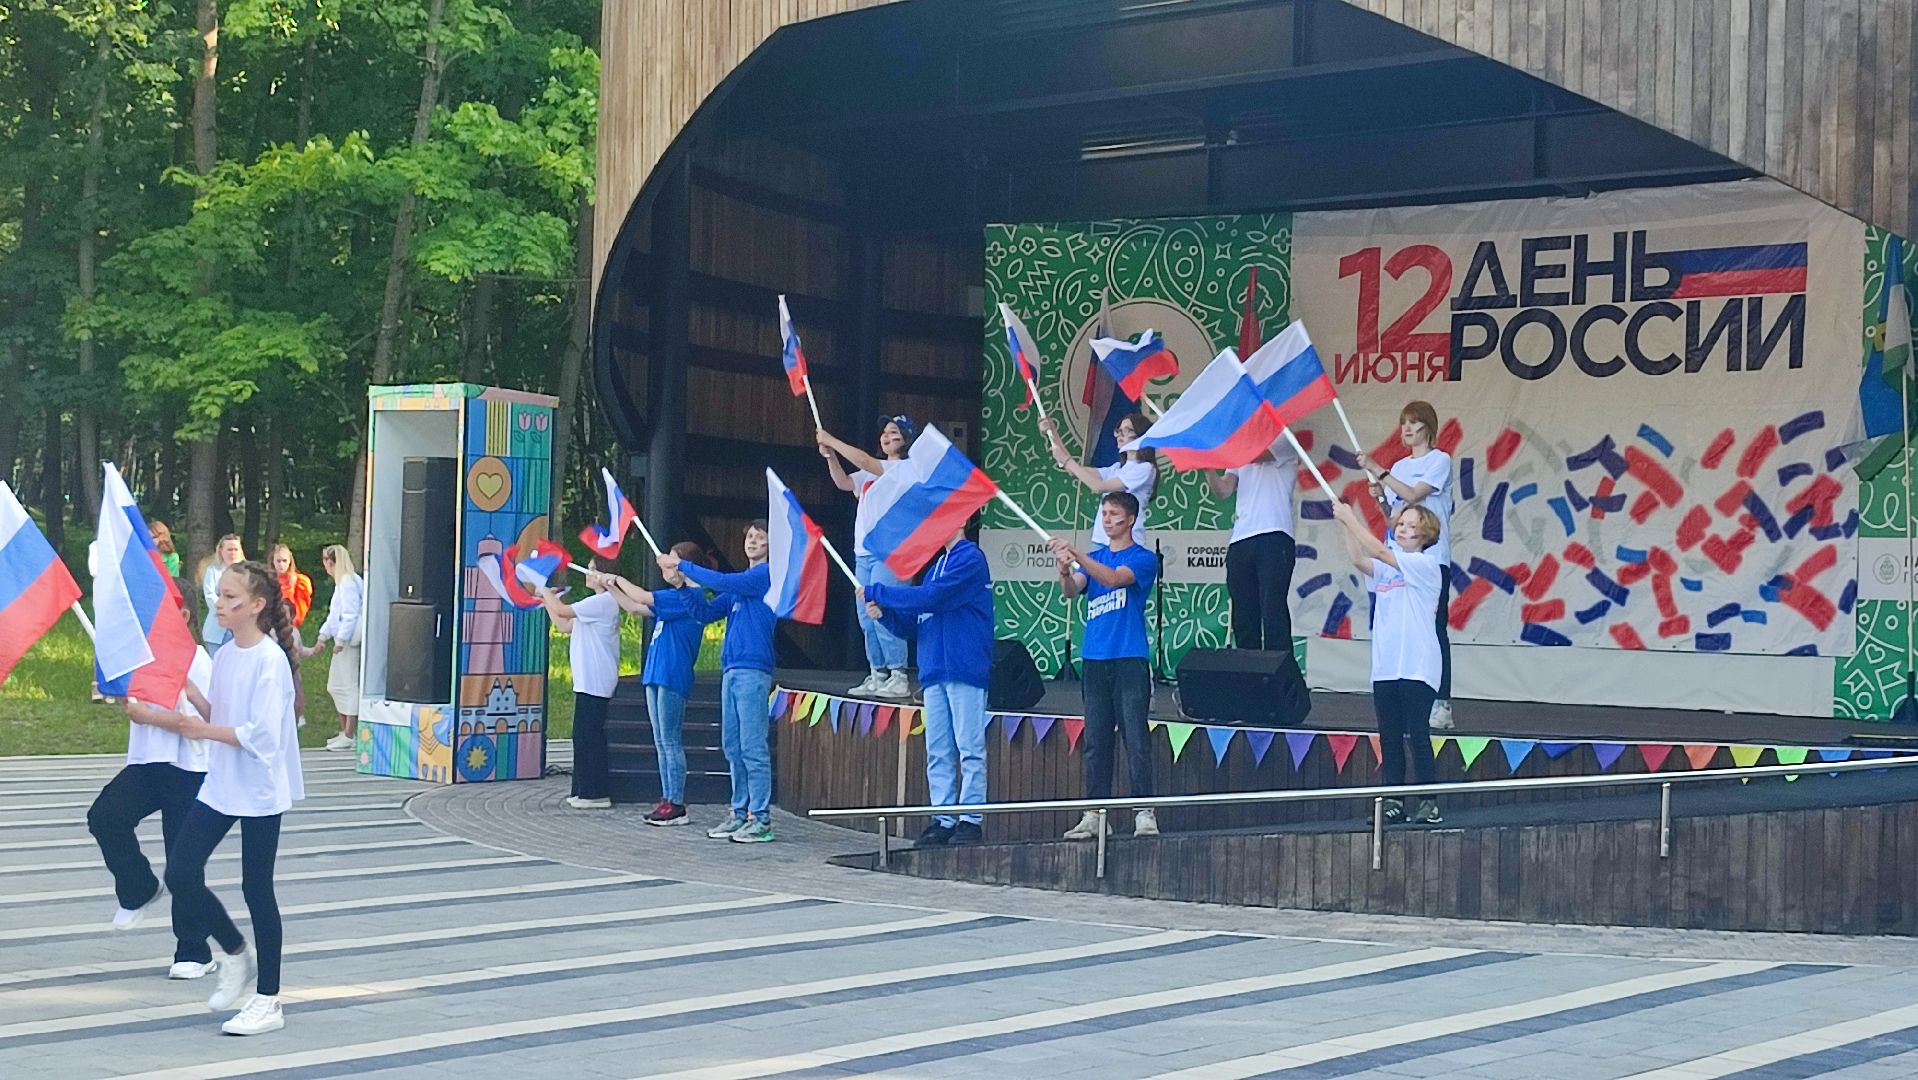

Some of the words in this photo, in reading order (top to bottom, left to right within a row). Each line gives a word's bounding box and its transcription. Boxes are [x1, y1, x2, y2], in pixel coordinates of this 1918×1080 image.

[1450, 230, 1685, 311] ДЕНЬ
[1338, 244, 1453, 354] 12
[1449, 294, 1807, 382] РОССИИ
[1334, 350, 1451, 384] ИЮНЯ
[1026, 556, 1058, 568] ПОД
[1027, 543, 1057, 555] ПАР
[1187, 546, 1228, 556] ГОРОДС
